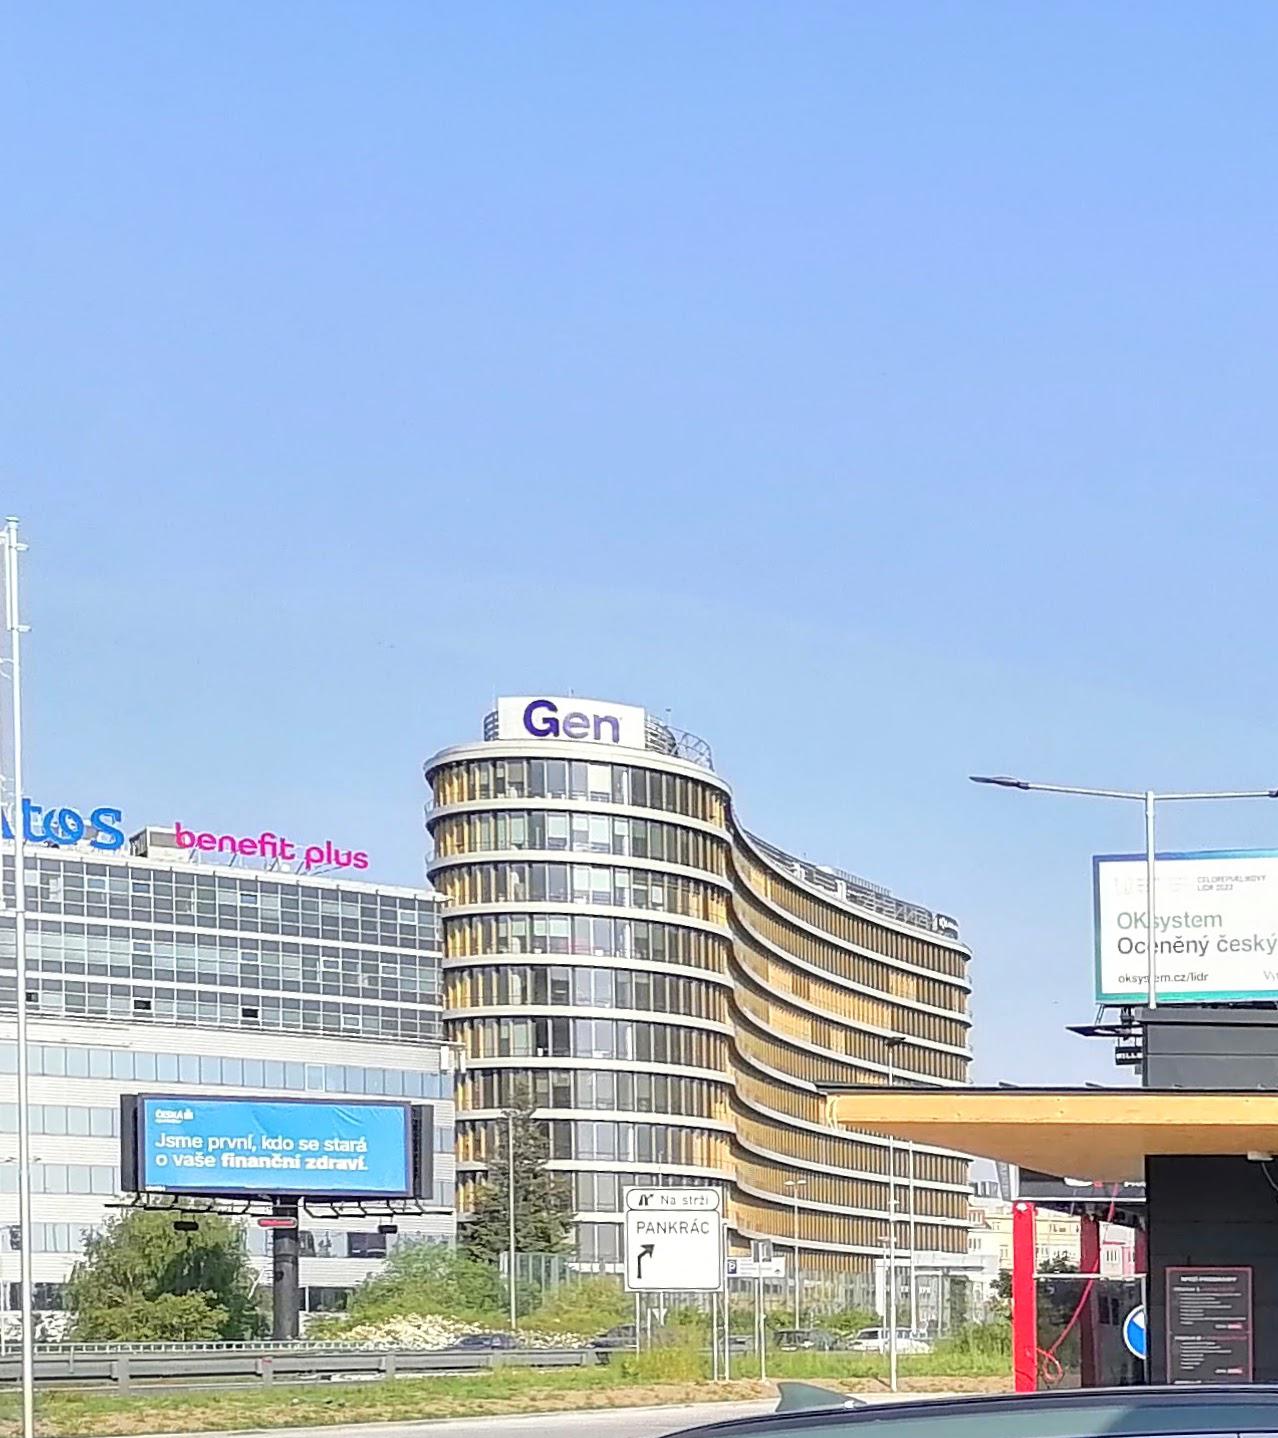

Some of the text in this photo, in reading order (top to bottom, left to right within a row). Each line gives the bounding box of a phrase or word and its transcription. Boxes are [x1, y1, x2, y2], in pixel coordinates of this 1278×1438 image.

[523, 699, 620, 743] Gen
[0, 798, 125, 850] tos
[175, 822, 369, 870] benefit plus
[1216, 933, 1278, 955] český
[155, 1133, 368, 1153] Jsme první, kdo se stará
[155, 1155, 168, 1167] o
[172, 1151, 216, 1168] vaše
[660, 1195, 676, 1205] Na
[636, 1218, 710, 1235] PANKRÁC
